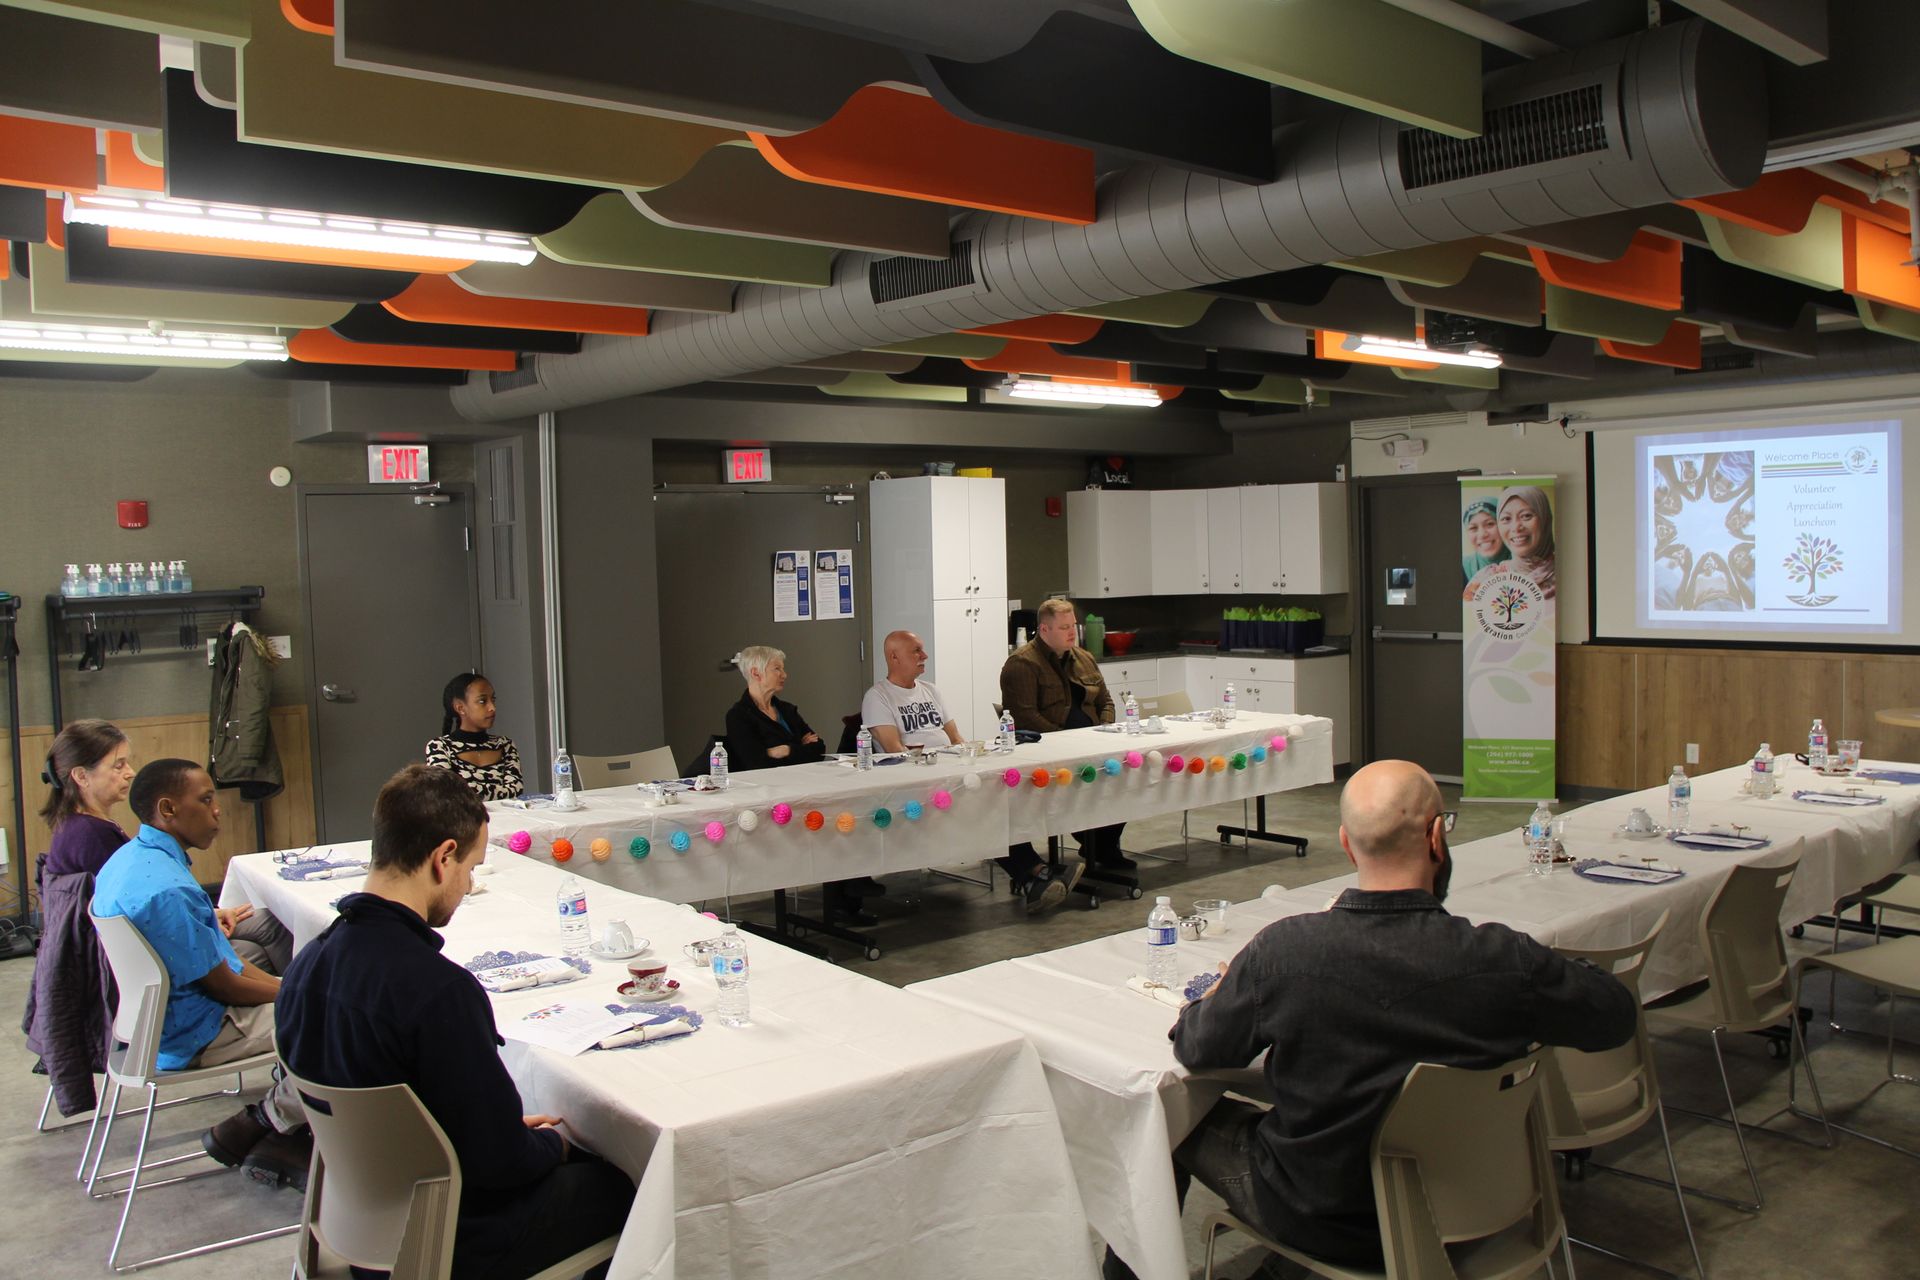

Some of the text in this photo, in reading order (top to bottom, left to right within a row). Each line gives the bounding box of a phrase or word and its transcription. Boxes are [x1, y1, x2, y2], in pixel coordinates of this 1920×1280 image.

[382, 448, 420, 480] EXIT
[733, 452, 763, 480] EXIT
[1764, 451, 1839, 462] Welcome Place
[1793, 483, 1837, 494] Volunteer
[1786, 501, 1844, 513] Appreciation
[1793, 516, 1836, 528] Luncheon
[1475, 573, 1542, 602] Manitoba Interfaith
[1476, 609, 1513, 640] Immigration
[901, 711, 942, 732] WPG
